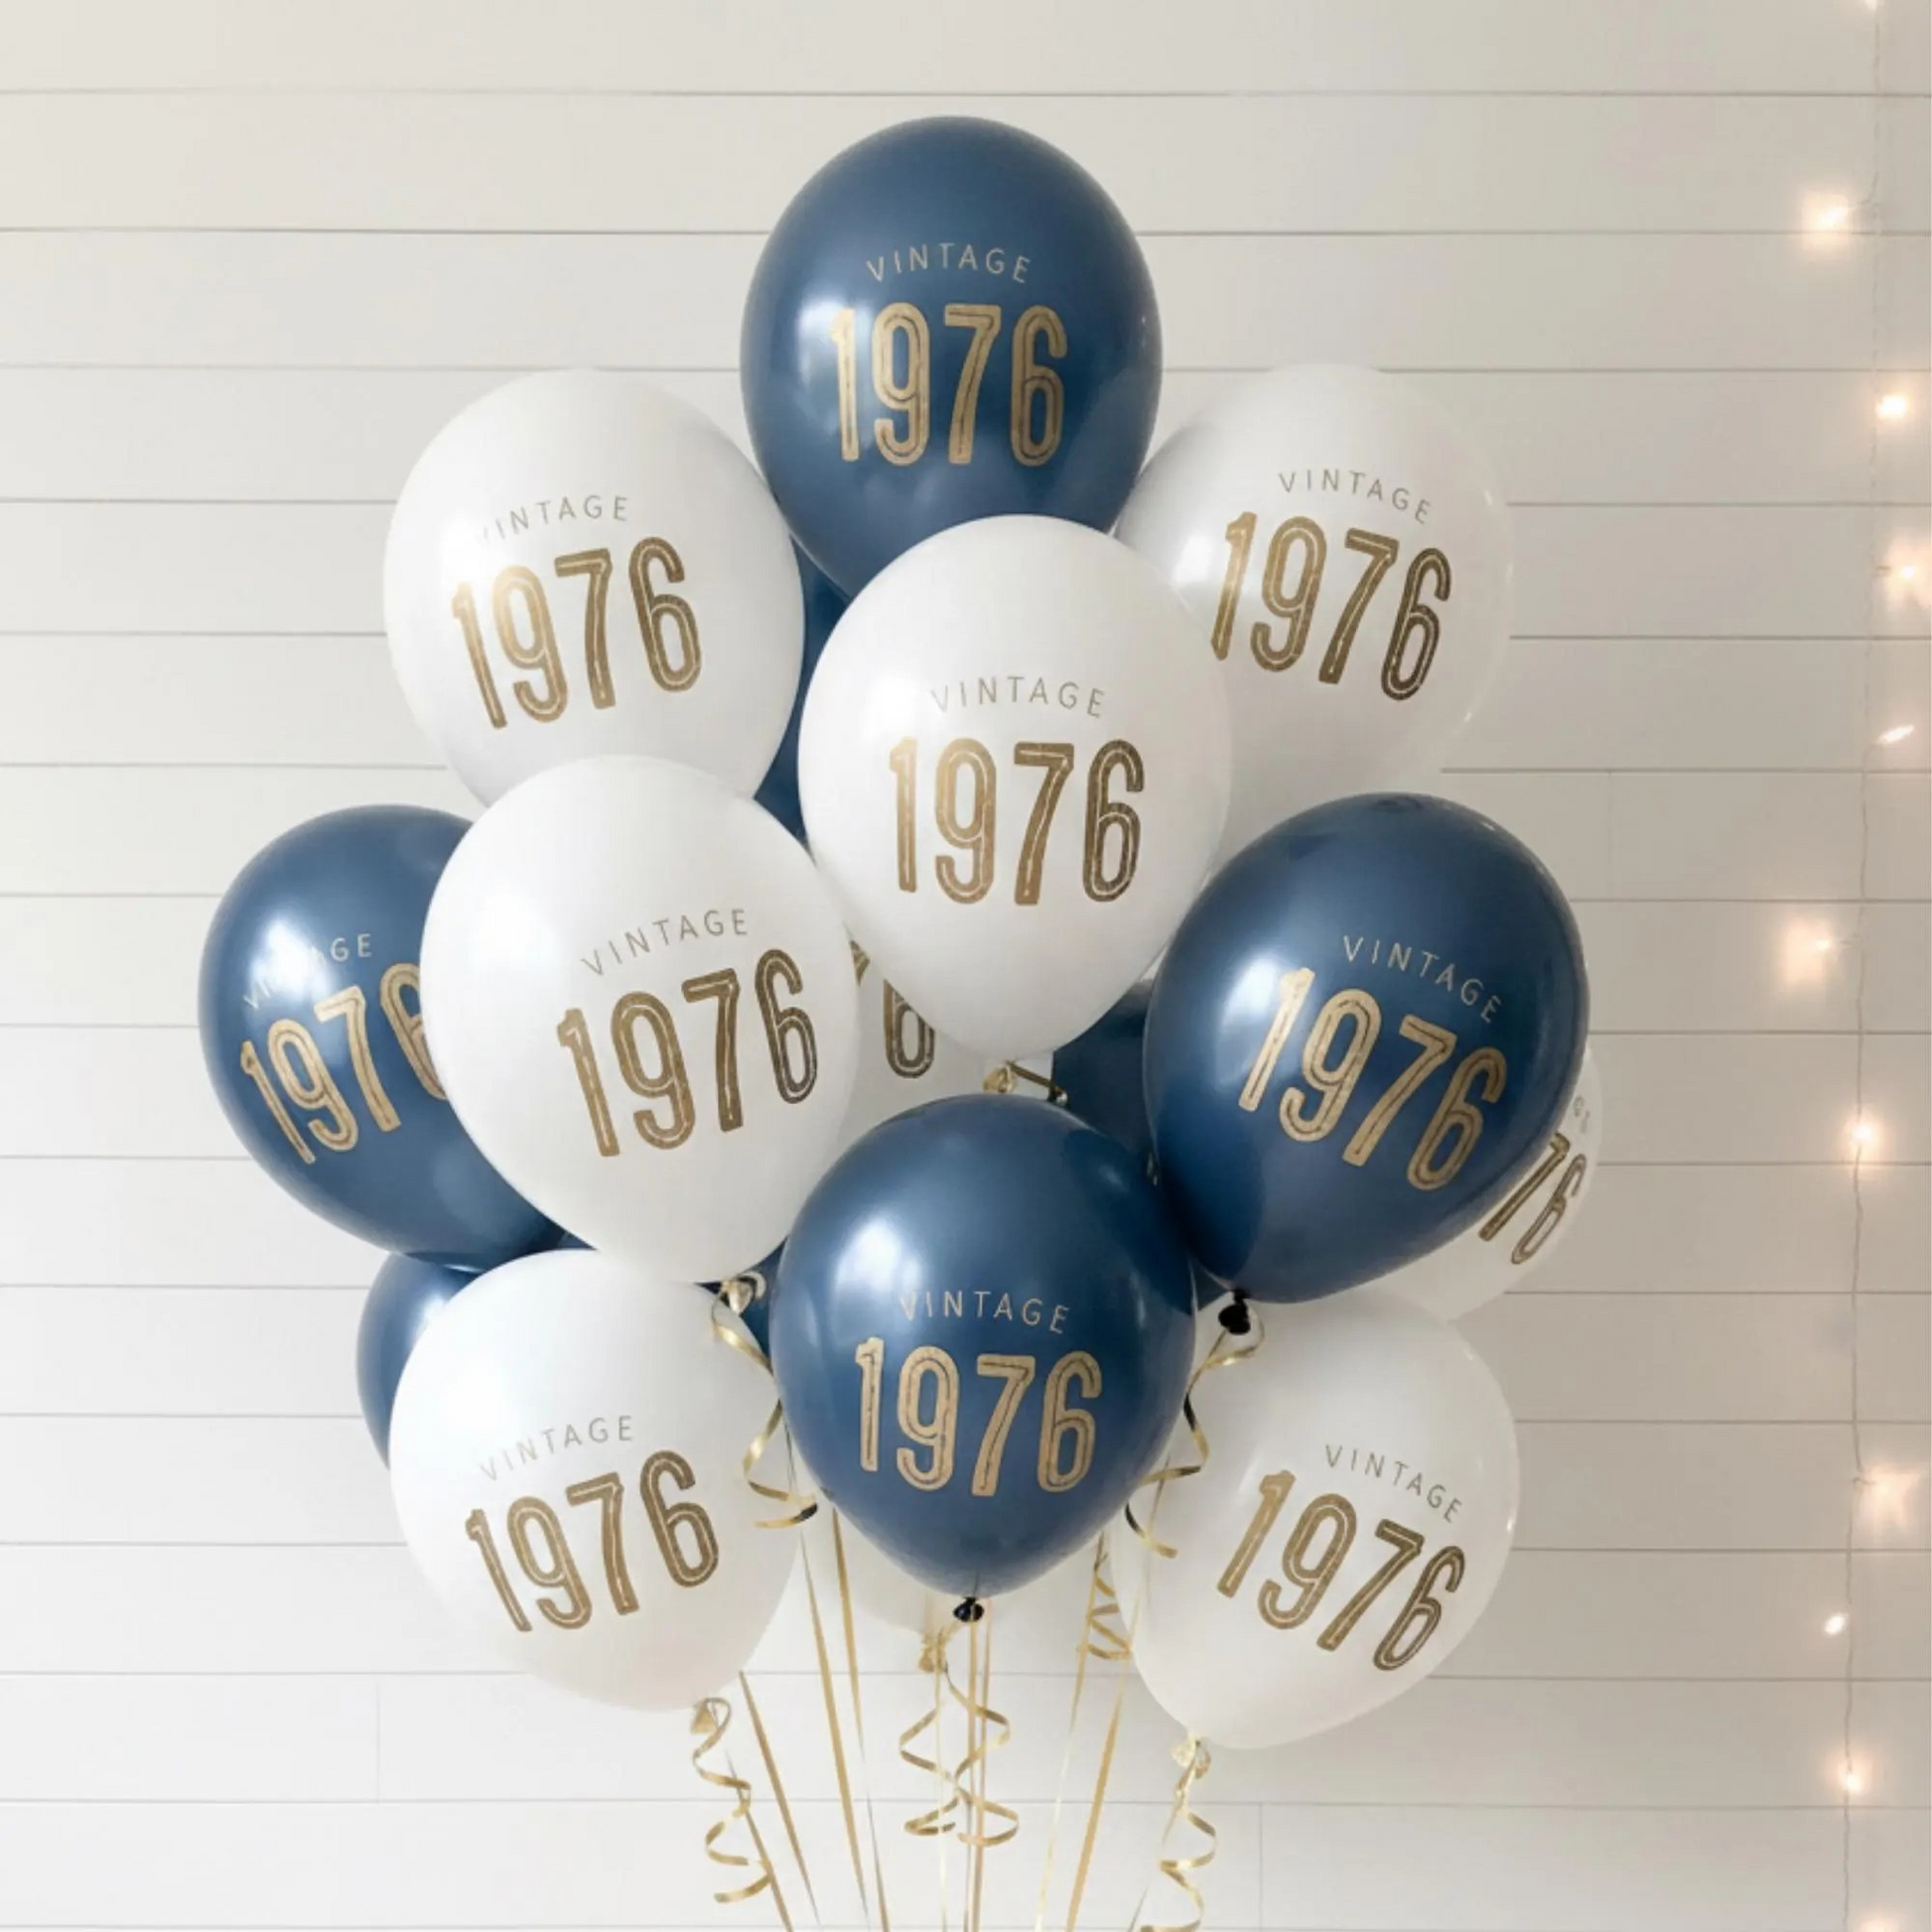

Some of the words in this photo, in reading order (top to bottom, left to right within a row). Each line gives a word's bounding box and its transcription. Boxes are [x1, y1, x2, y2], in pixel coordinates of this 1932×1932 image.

[866, 242, 1031, 283] VINTAGE
[830, 302, 1067, 467] 1976
[483, 494, 627, 541] INTAGE
[1278, 469, 1432, 524] VINTAGE
[452, 537, 702, 730] 1976
[1210, 511, 1450, 700] 1976
[930, 676, 1105, 718] VINTAGE
[890, 737, 1145, 905] 1976
[580, 908, 748, 976] VINTAGE
[1343, 935, 1501, 1025] VINTAGE
[556, 949, 817, 1157] 1976
[1238, 967, 1507, 1191] 1976
[899, 1291, 1069, 1333] VINTAGE
[480, 1415, 633, 1481] VINTAGE
[855, 1336, 1102, 1496] 1976
[466, 1449, 719, 1632] 1976
[1325, 1445, 1462, 1523] VINTAGE
[1216, 1469, 1465, 1671] 1976
